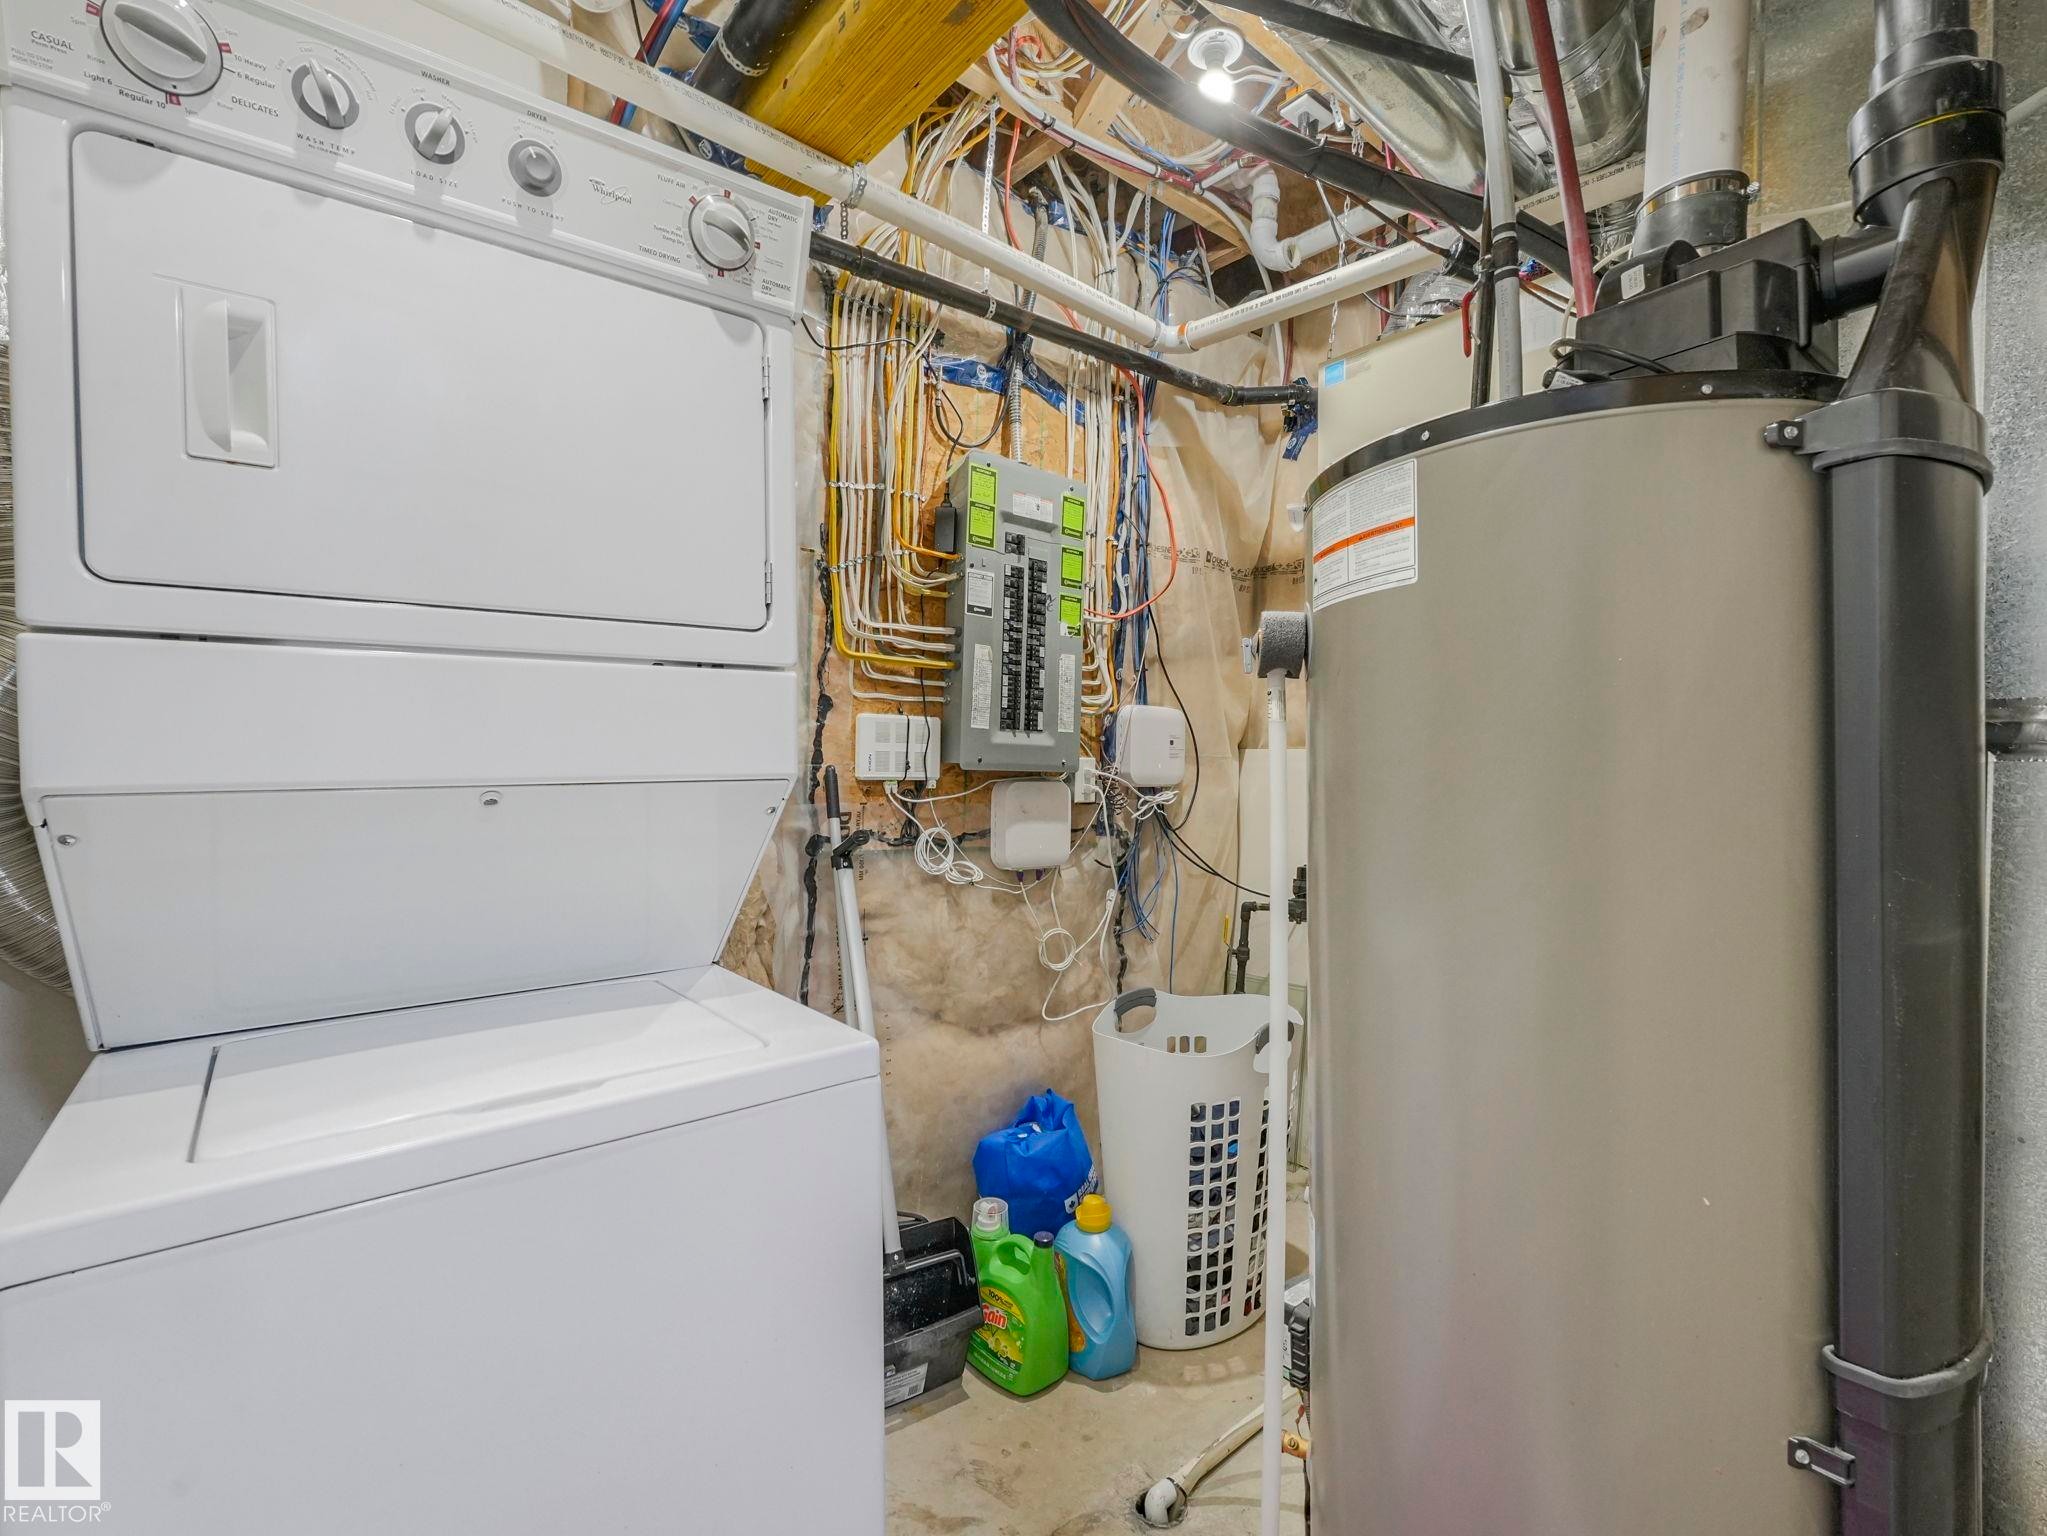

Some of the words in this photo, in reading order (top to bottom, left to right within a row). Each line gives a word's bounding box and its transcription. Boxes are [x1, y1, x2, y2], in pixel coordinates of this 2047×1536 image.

[31, 30, 75, 51] CASUAL
[244, 58, 267, 71] Heavy
[83, 71, 105, 84] Light
[107, 78, 113, 86] 6
[237, 71, 243, 79] 6
[245, 73, 276, 90] Regular
[421, 70, 451, 86] WASHER
[119, 88, 154, 105] Regular
[156, 100, 166, 109] 10
[231, 95, 279, 117] DELICATES
[527, 109, 548, 122] DRYER
[296, 131, 324, 146] WASH
[410, 169, 434, 181] LOAD
[439, 177, 458, 188] SIZE
[675, 180, 686, 190] AIR
[592, 184, 632, 205] Whirlpool
[502, 198, 523, 209] PUSH
[527, 205, 537, 214] TO
[541, 210, 565, 222] START
[768, 208, 799, 224] AUTOMATIC
[767, 214, 779, 223] DRY
[653, 224, 670, 234] Tumble
[662, 234, 676, 244] Damp
[676, 239, 686, 247] Dry
[639, 244, 658, 257] TIMED
[658, 250, 682, 265] DRYING
[761, 277, 792, 292] AUTOMATIC
[761, 284, 772, 292] DRY
